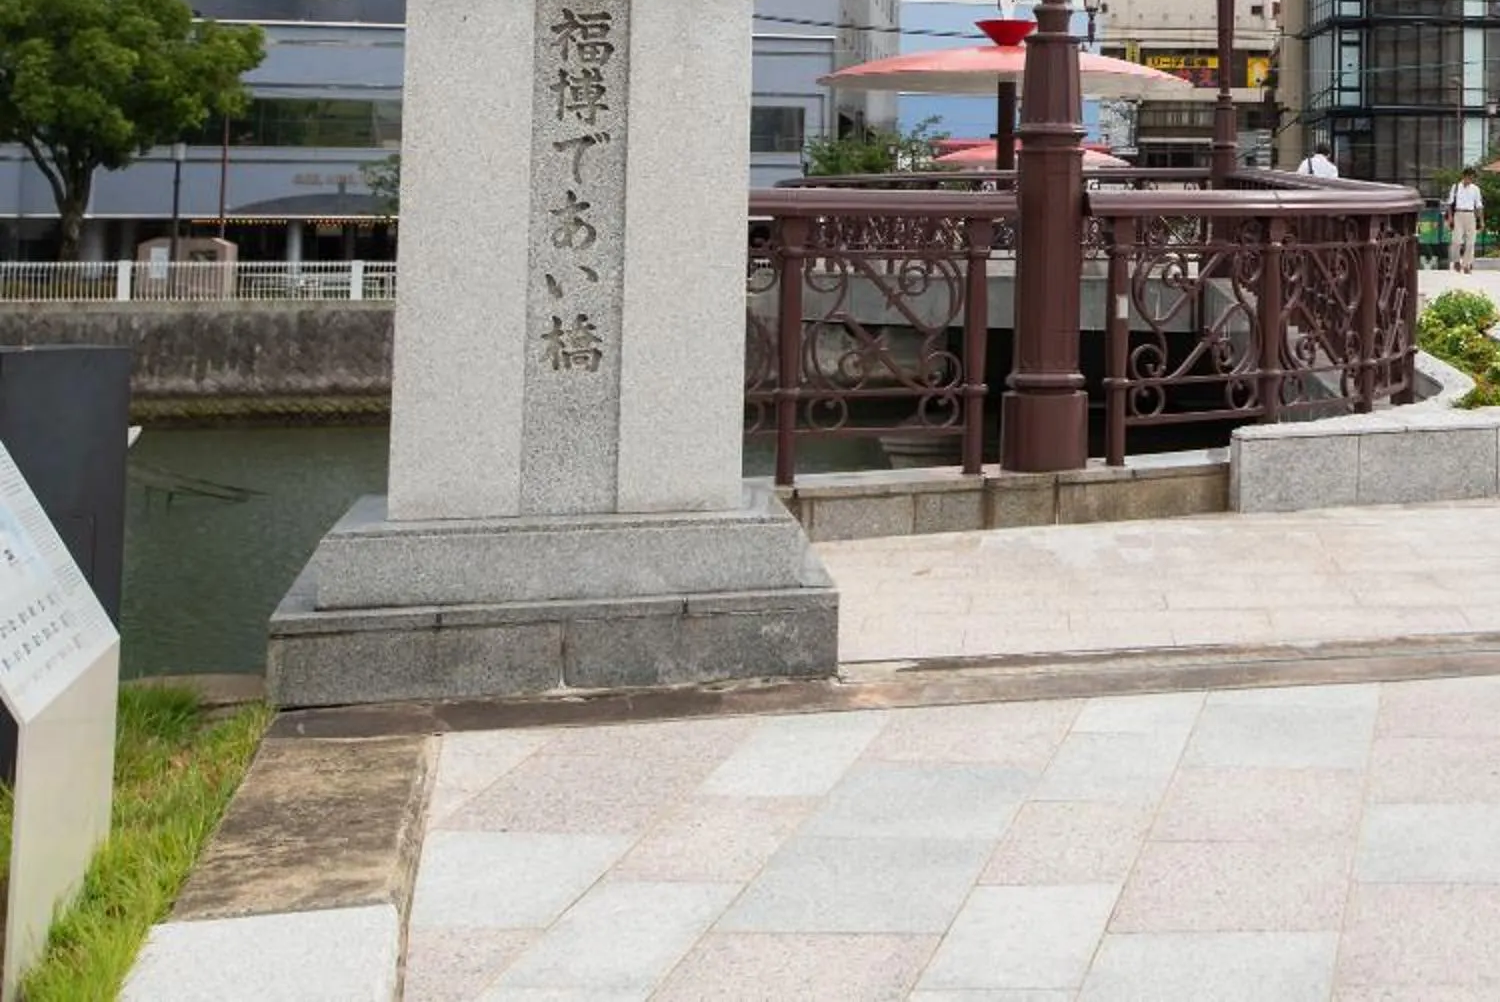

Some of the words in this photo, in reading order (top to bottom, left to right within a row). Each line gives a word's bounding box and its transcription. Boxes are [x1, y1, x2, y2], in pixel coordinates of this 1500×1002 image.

[541, 7, 615, 373] 福博であい橋
